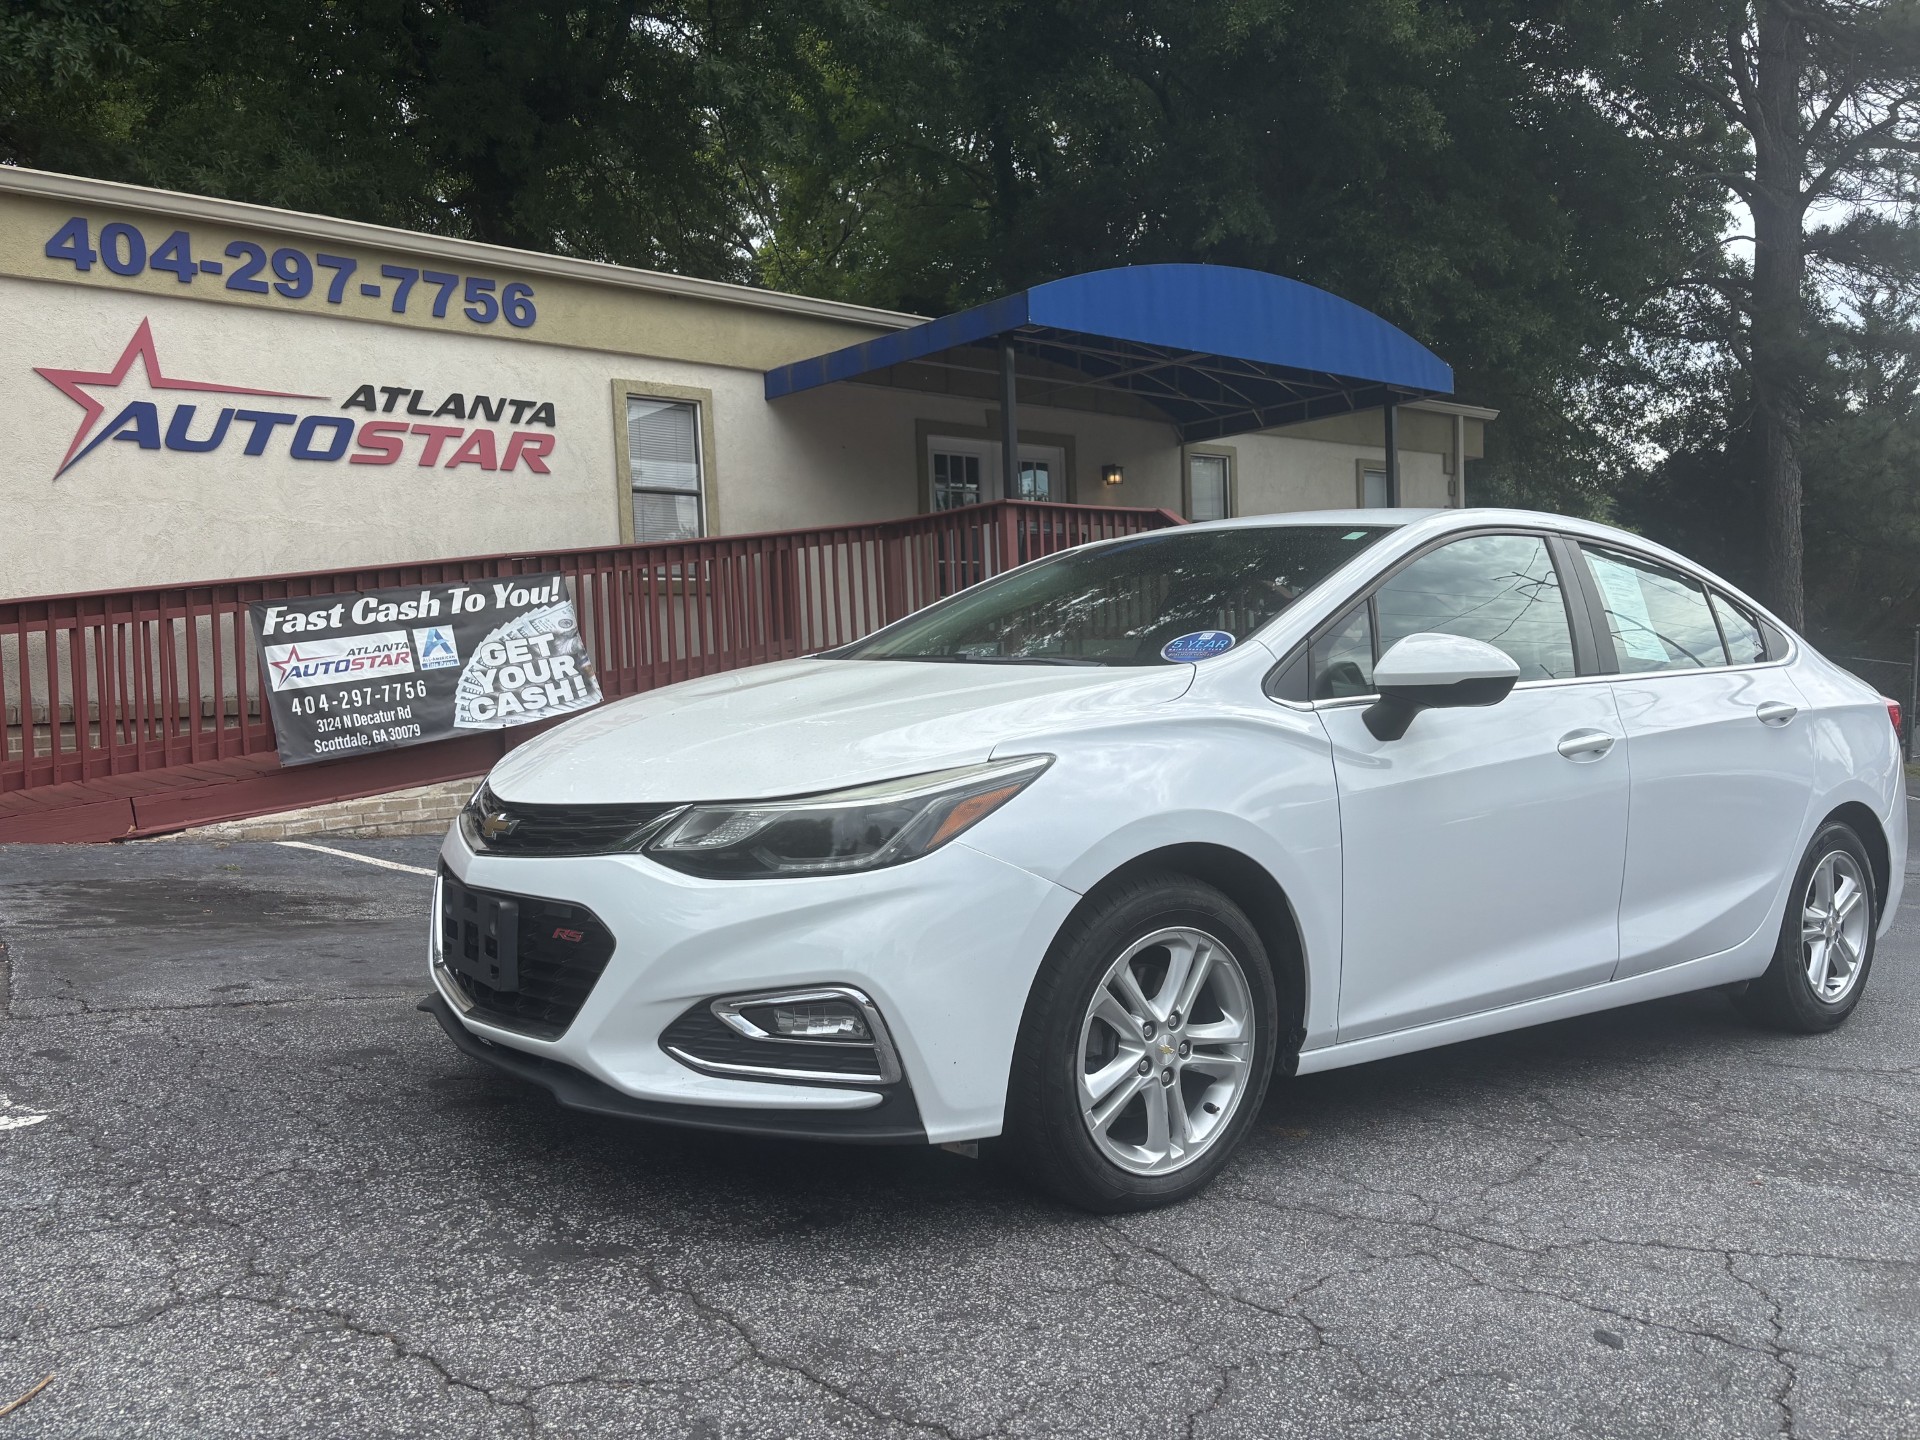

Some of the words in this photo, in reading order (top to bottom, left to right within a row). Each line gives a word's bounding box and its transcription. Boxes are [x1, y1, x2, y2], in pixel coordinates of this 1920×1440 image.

[45, 216, 537, 328] 404-297-7756
[341, 384, 556, 427] ATLANTA
[95, 400, 556, 474] AUTOSTAR
[262, 603, 346, 636] Fast
[351, 590, 441, 625] Cash
[448, 587, 485, 614] To
[493, 576, 560, 609] You!
[346, 641, 409, 657] ATLANTA
[480, 633, 554, 667] GET
[1171, 640, 1185, 649] 5
[1187, 639, 1229, 648] YEAR
[285, 651, 411, 680] AUTOSTAR
[472, 655, 579, 693] YOUR
[291, 680, 427, 716] 404-297-7756
[469, 675, 588, 721] CASH!
[316, 718, 342, 733] 3124
[343, 715, 352, 729] N
[354, 710, 396, 727] Decatur
[398, 705, 412, 720] Rd
[314, 732, 372, 753] Scottdale,
[372, 729, 388, 744] GA
[389, 723, 421, 741] 30079
[552, 928, 584, 942] RS
